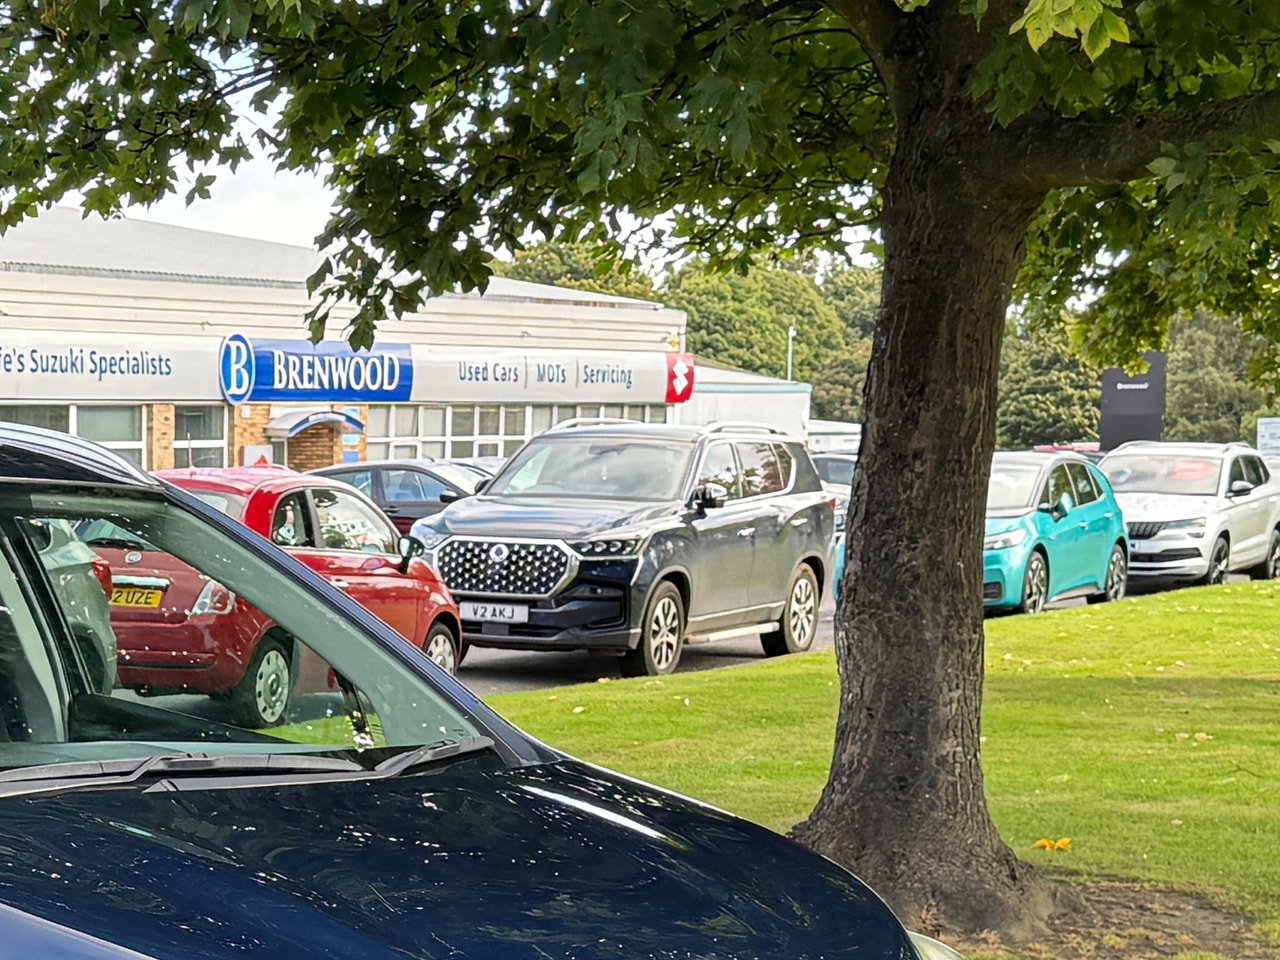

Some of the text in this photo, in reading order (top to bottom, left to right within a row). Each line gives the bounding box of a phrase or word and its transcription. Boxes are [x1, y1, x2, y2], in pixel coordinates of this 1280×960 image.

[30, 348, 84, 375] Suzuki
[89, 350, 172, 382] Specialists
[272, 350, 400, 391] BRENWOOD
[458, 361, 633, 389] Used Cars MOTs Servicing
[125, 591, 155, 605] UZE
[472, 606, 515, 620] V2 AKJ
